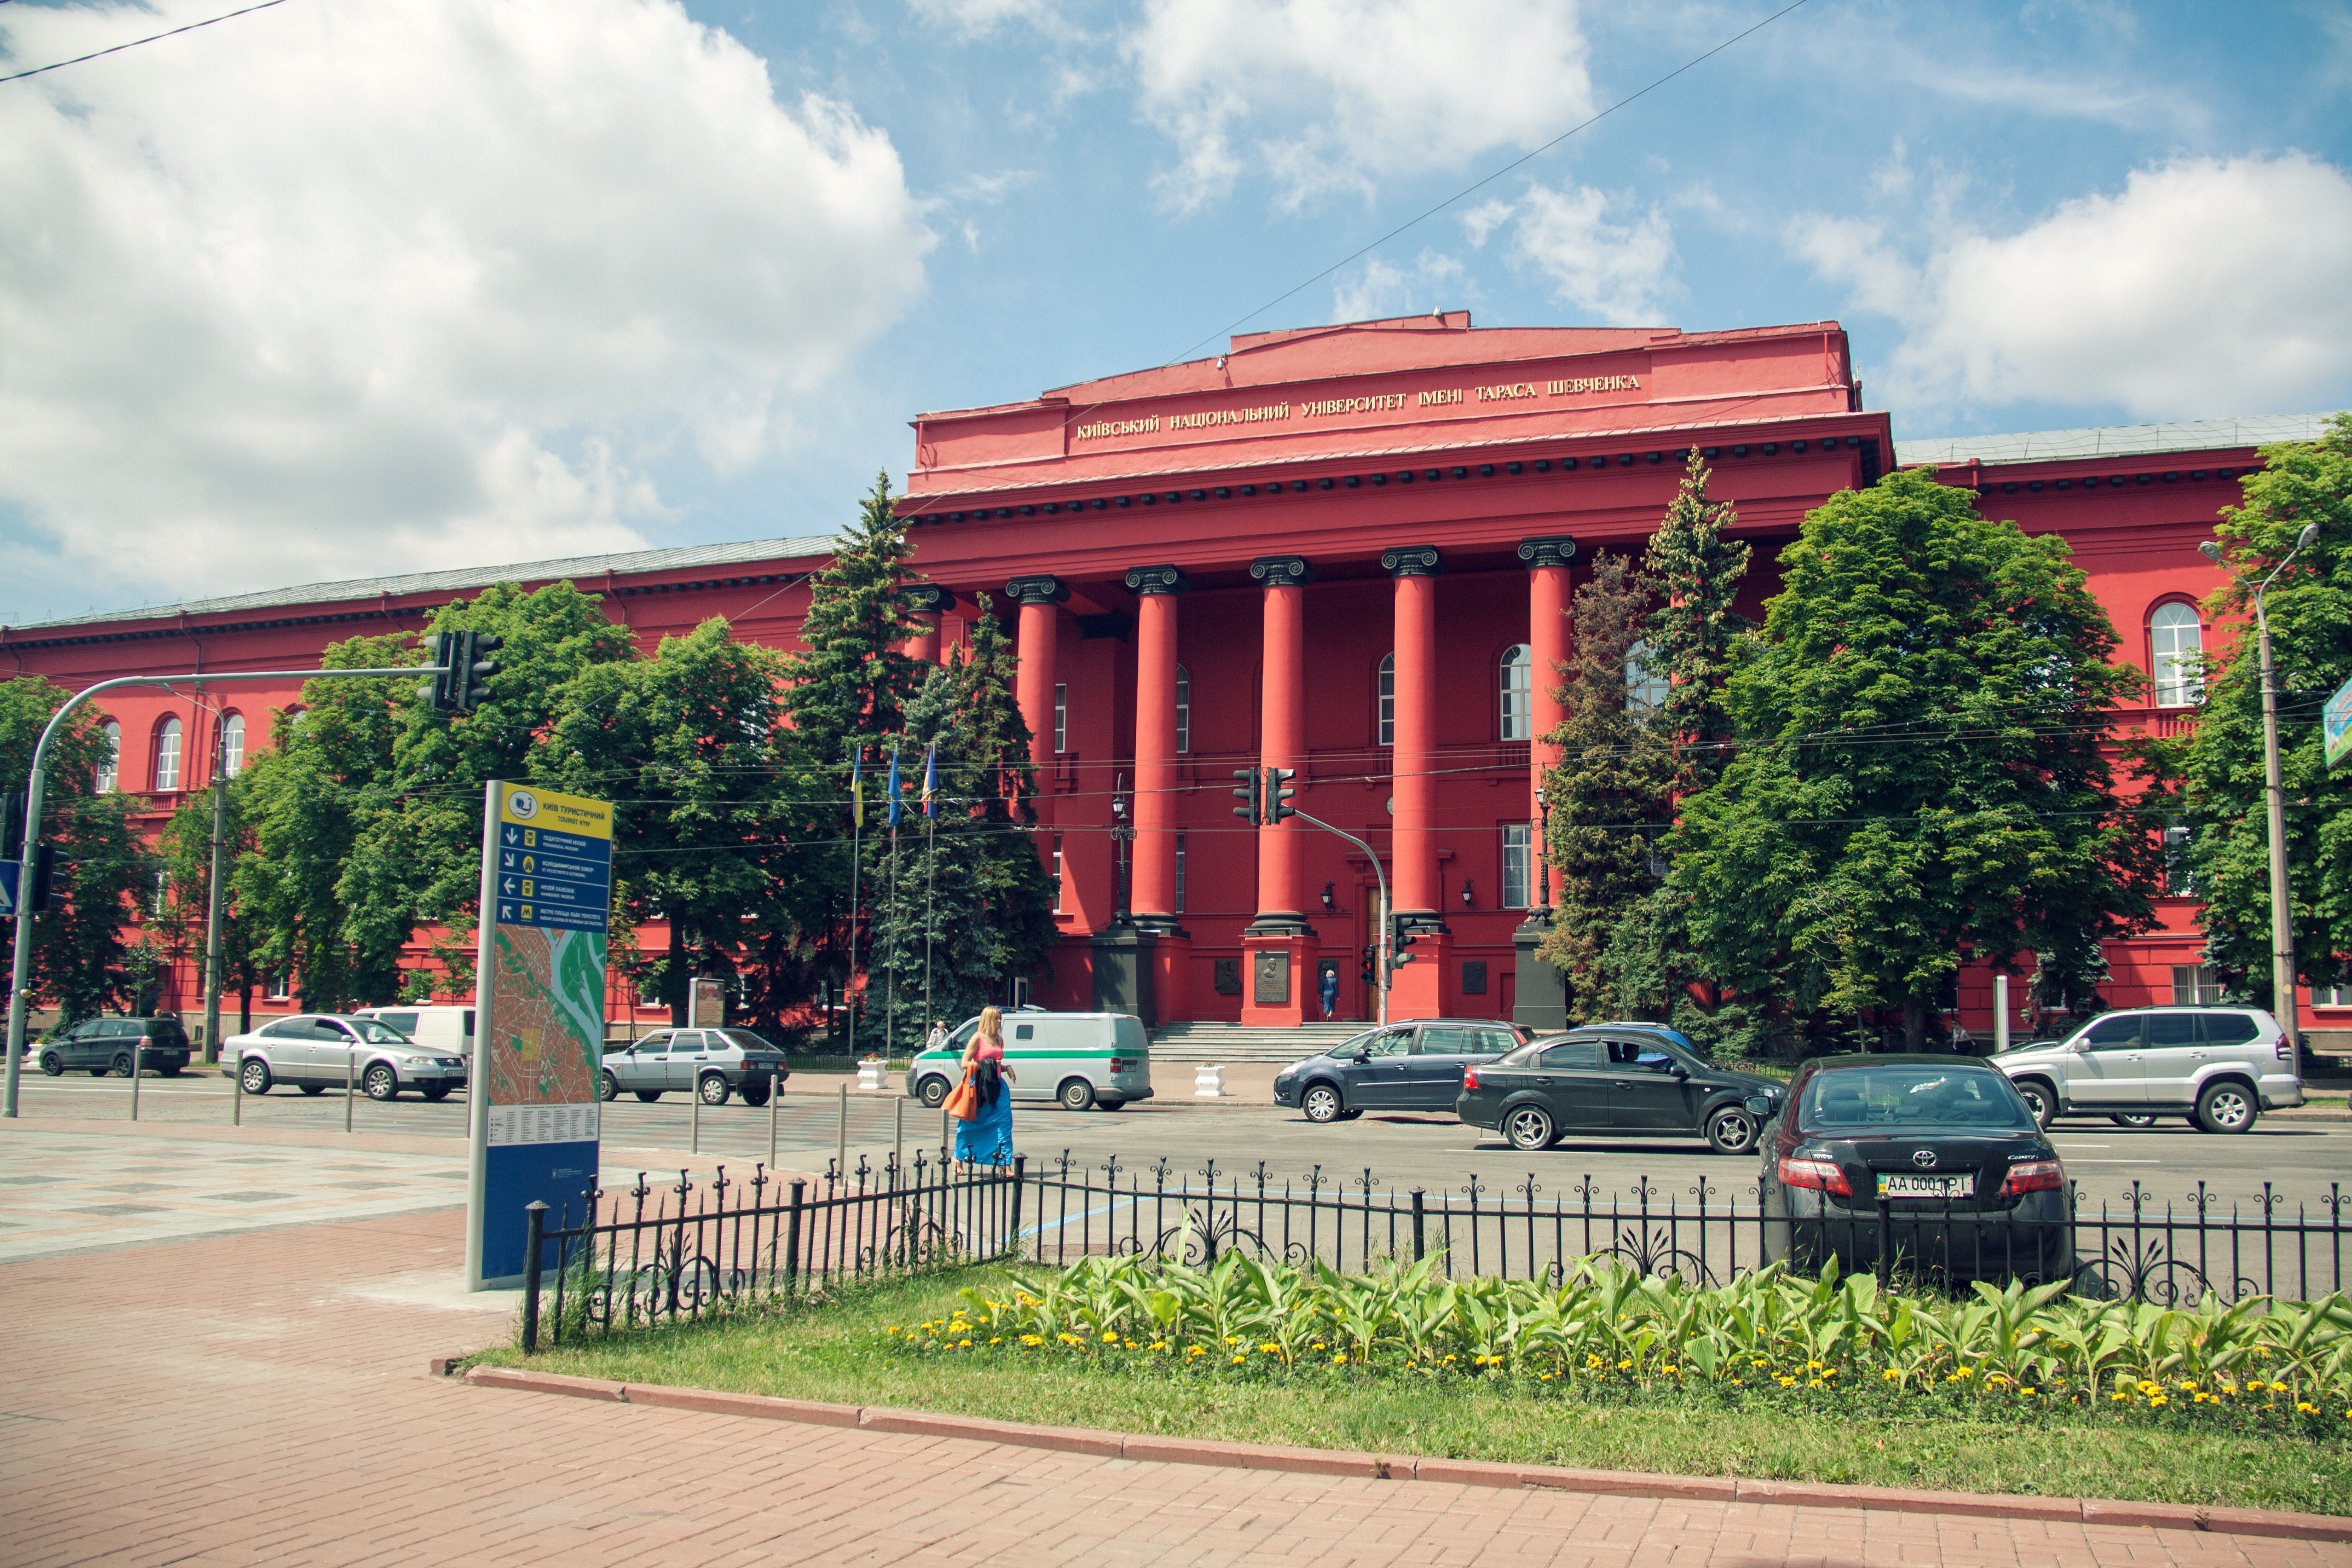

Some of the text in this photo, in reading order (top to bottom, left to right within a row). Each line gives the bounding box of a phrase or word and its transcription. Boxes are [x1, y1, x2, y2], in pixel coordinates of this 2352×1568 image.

[1077, 374, 1641, 440] КИЇВСЬКИЙ НАЦІОНАЛЬНИЙ УНІВЕРСИТЕТ ІМЕНІ ТАРАСА ШЕВЧЕНКА
[543, 802, 605, 820] КИЇВ ТУРИСТИЧНИЙ
[558, 815, 578, 825] TOURIST
[1888, 1177, 1908, 1191] AA
